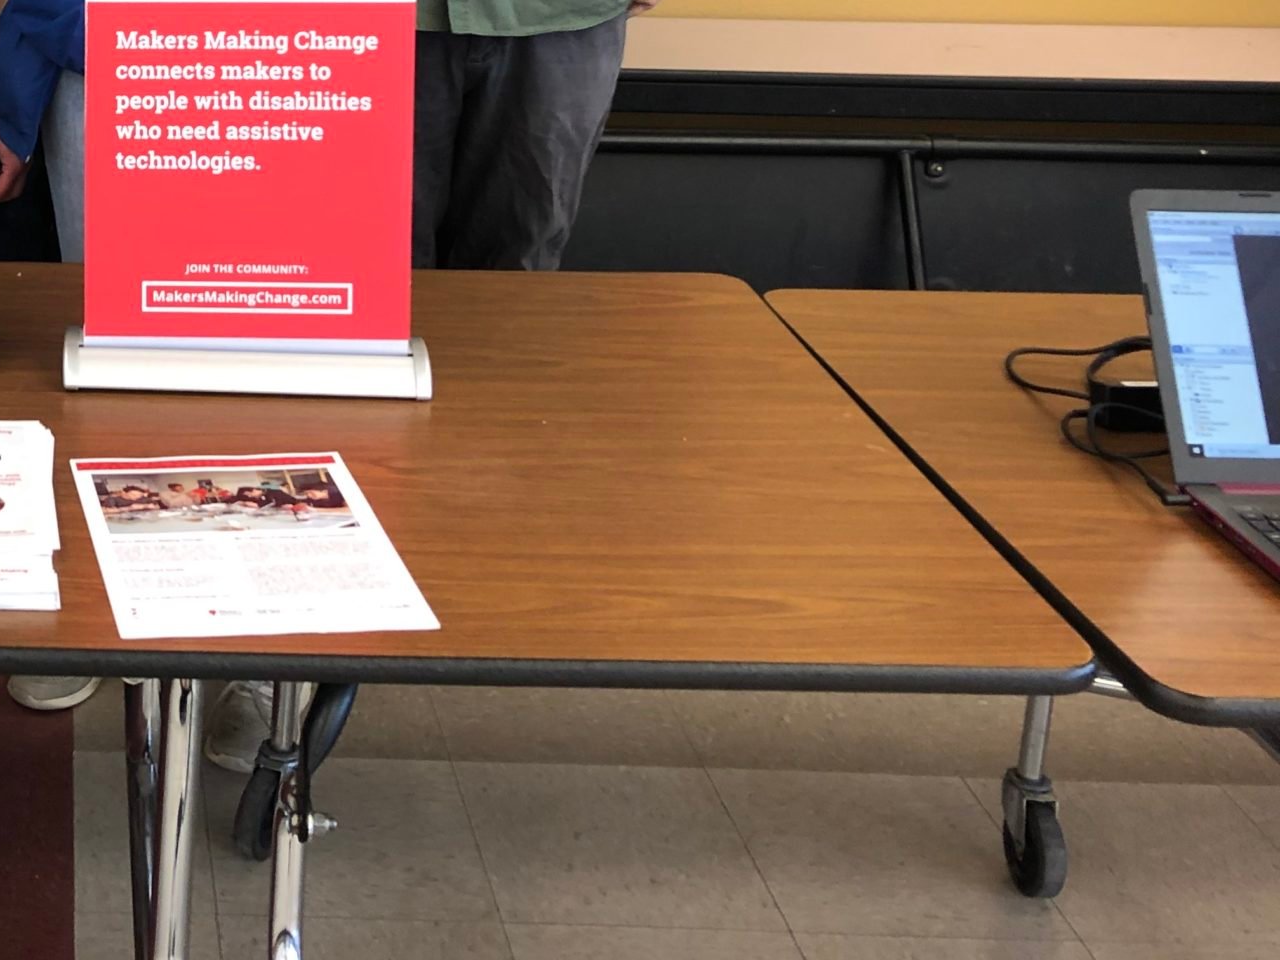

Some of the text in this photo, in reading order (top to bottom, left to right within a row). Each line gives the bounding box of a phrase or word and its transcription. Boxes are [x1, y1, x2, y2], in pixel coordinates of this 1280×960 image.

[116, 30, 379, 55] Makers Making Change
[115, 60, 331, 81] connects makers to
[115, 90, 372, 114] people with disabilities
[115, 120, 324, 141] who need assistive
[115, 150, 261, 175] technologies.
[184, 263, 308, 275] JOIN THE COMMUNITY:
[152, 289, 342, 307] MakersMakingChange.com
